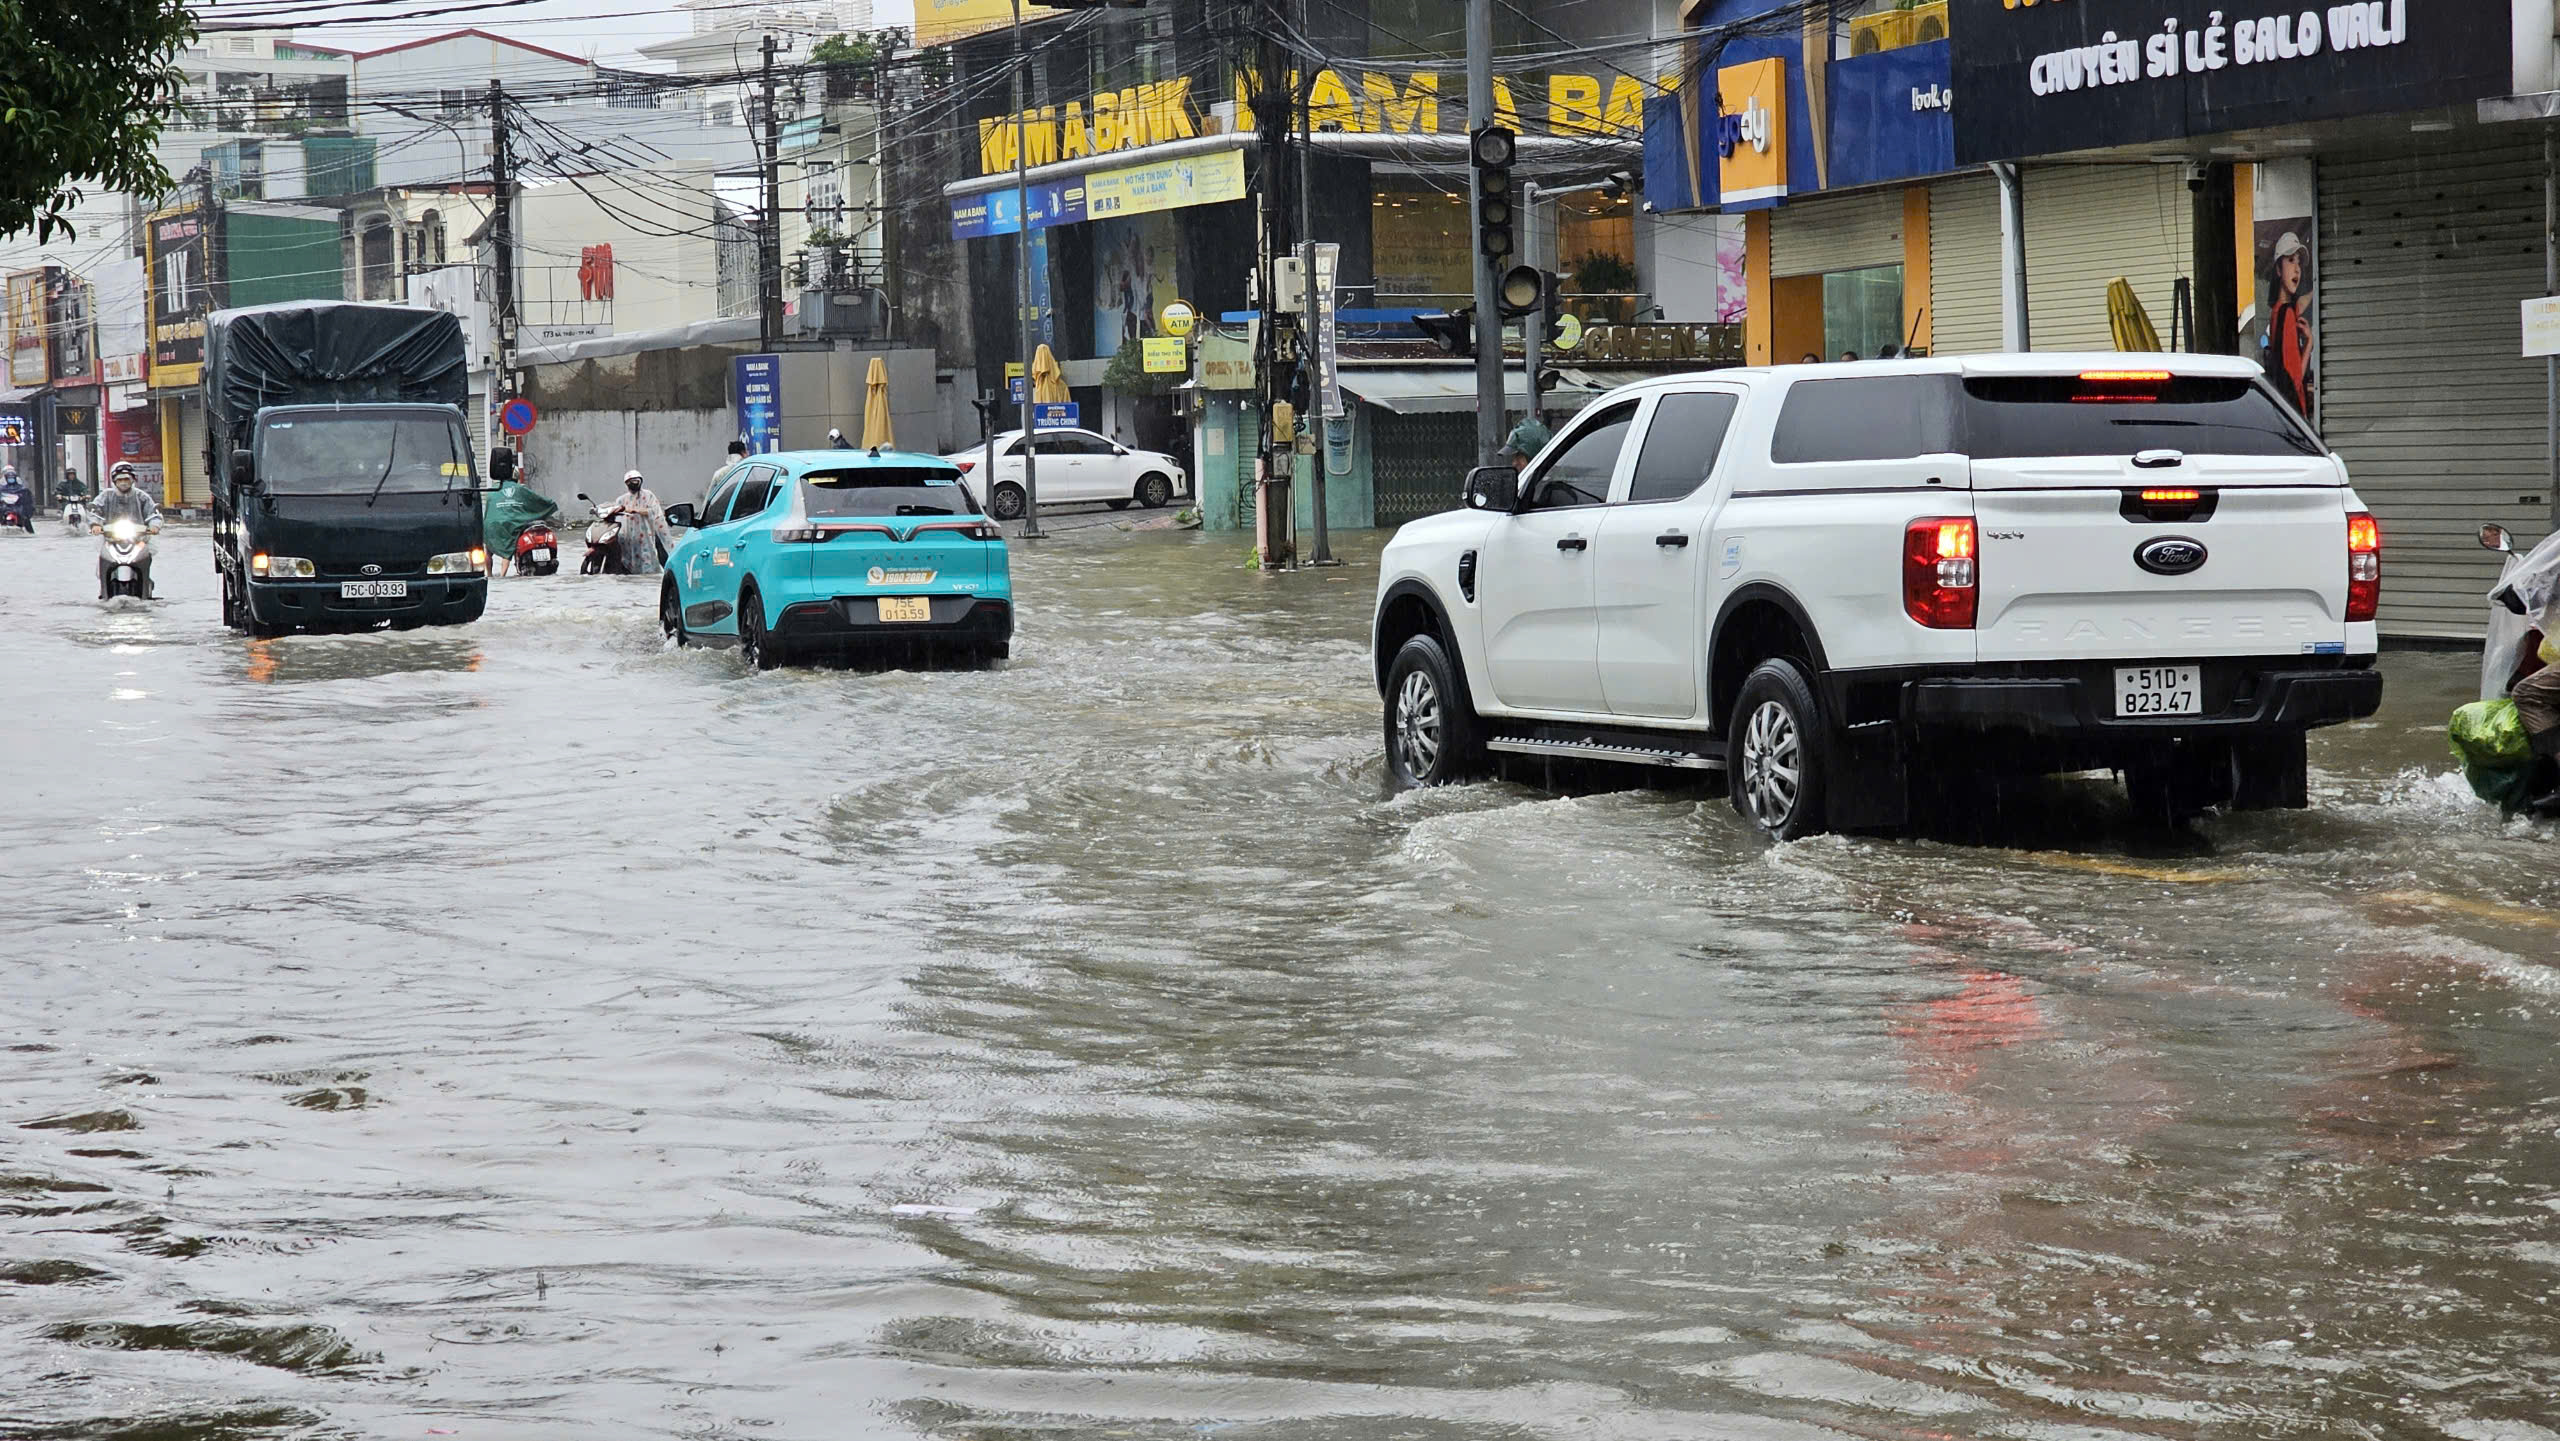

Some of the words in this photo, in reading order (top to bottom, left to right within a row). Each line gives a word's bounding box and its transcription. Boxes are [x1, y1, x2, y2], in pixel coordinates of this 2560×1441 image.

[2030, 31, 2139, 96] CHUYÊN
[2146, 17, 2180, 77] SỈ
[2185, 10, 2228, 72] LẺ
[2234, 11, 2322, 65] BALO
[2327, 0, 2406, 52] VALI
[1911, 84, 1942, 112] look
[979, 105, 1058, 175] NAM
[1062, 101, 1089, 160] A
[1093, 76, 1195, 153] BANK
[1717, 96, 1770, 158] yody
[543, 330, 554, 338] 173
[1170, 319, 1190, 329] ATM
[1585, 326, 1697, 360] GREEN
[2158, 545, 2195, 564] Ford
[886, 572, 904, 583] 1900
[885, 608, 925, 619] 013.59
[895, 597, 915, 608] 75E
[2013, 616, 2317, 642] RANGER
[2139, 668, 2177, 690] 51D
[2125, 691, 2192, 714] 823.47
